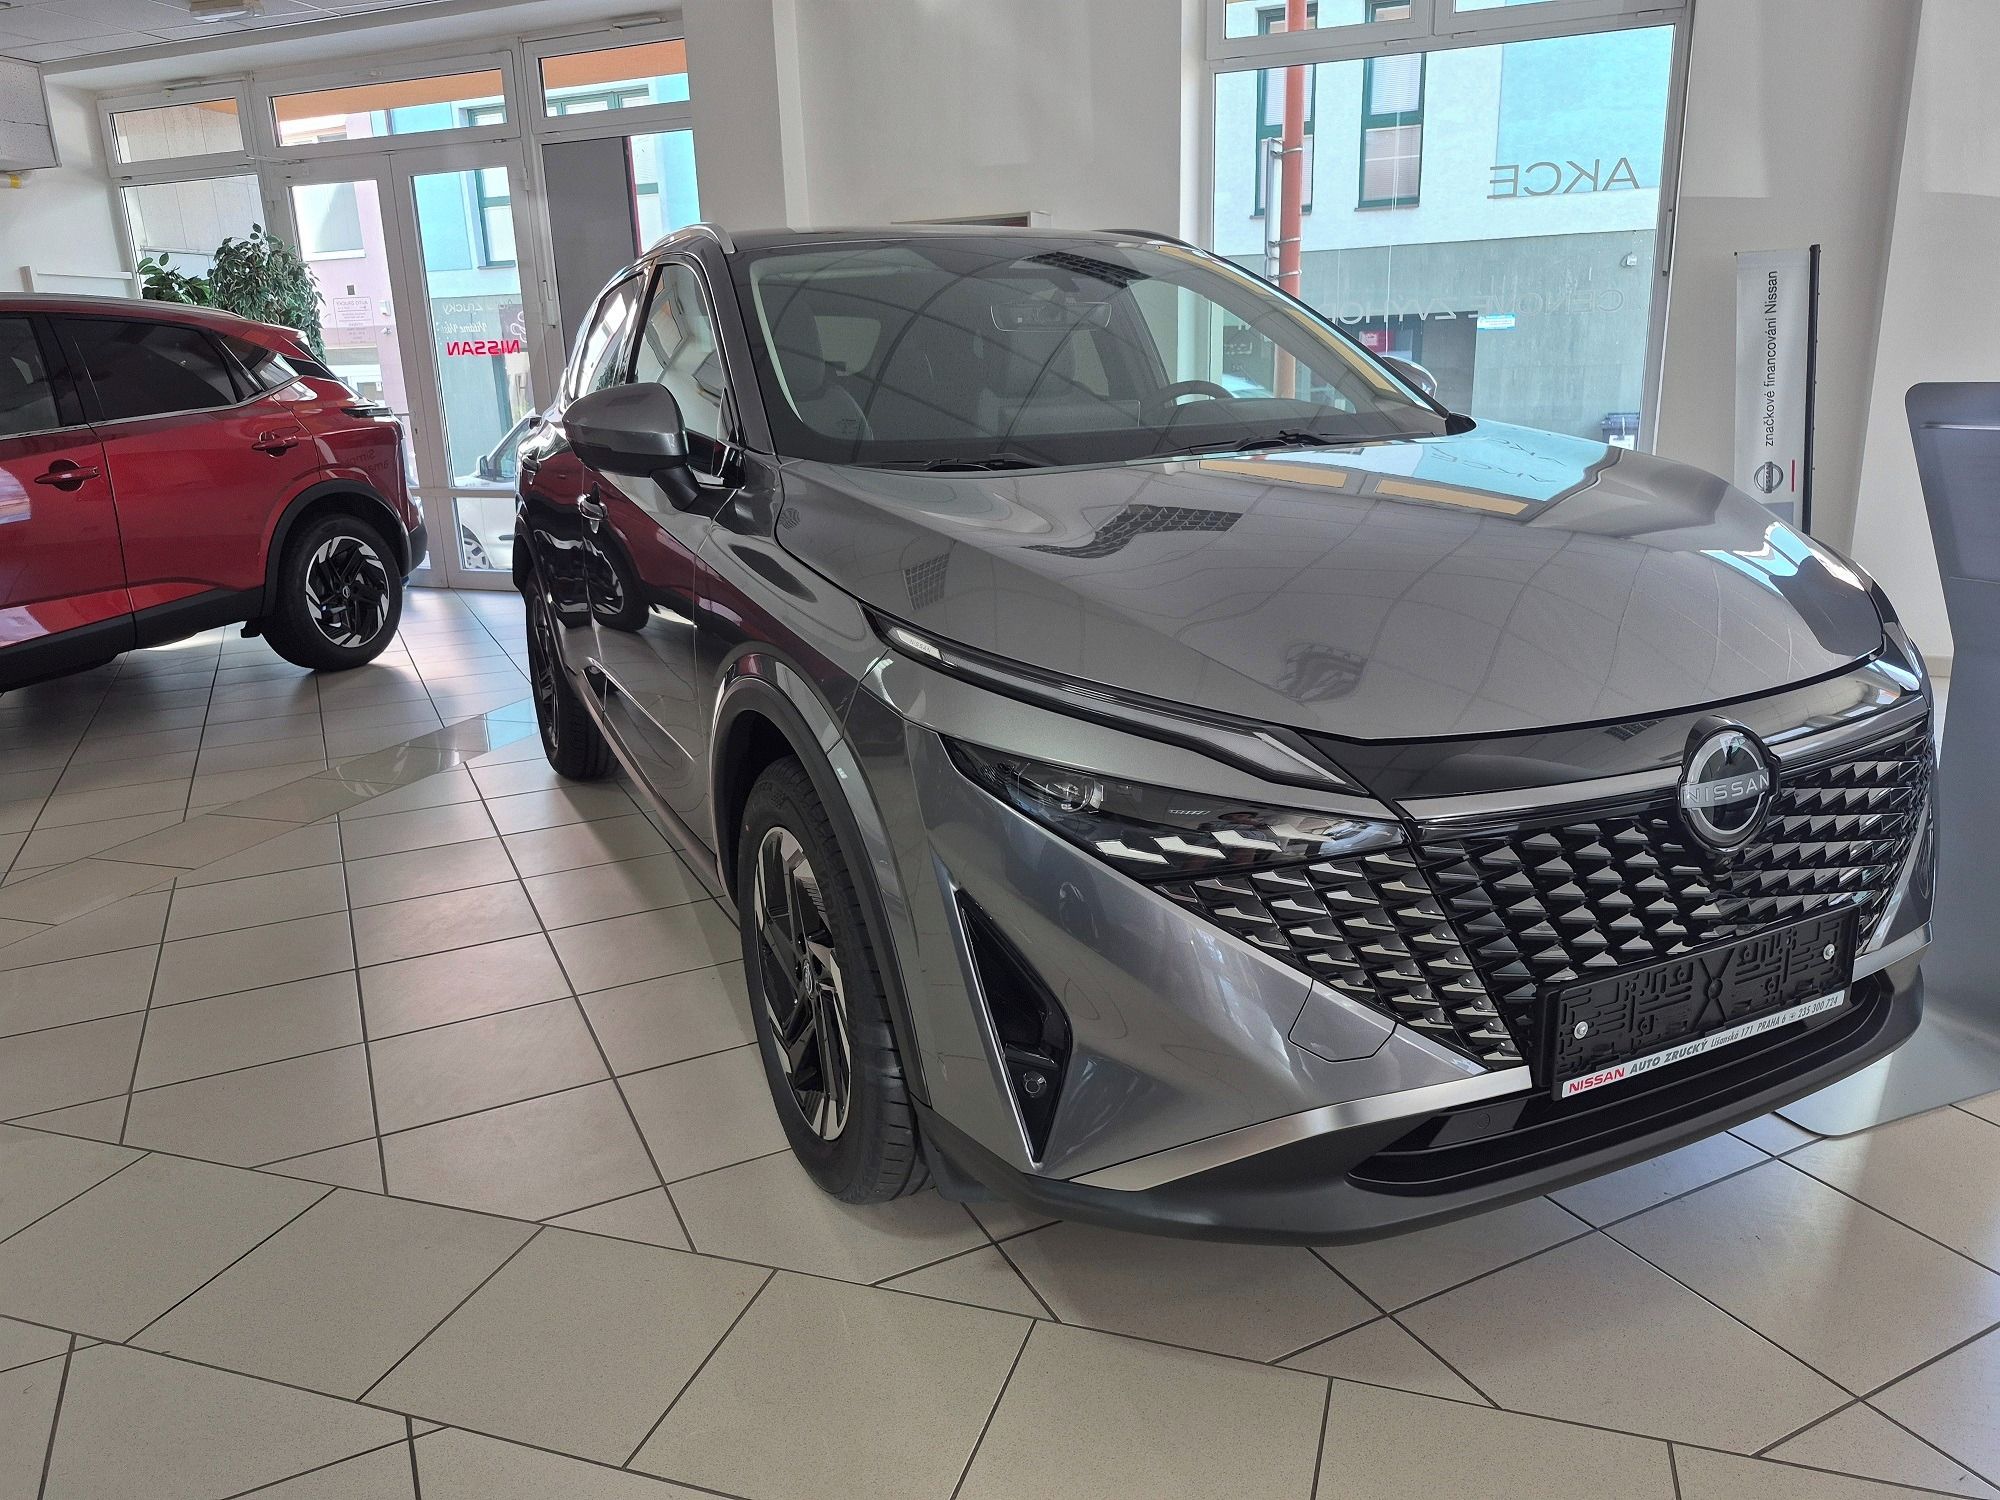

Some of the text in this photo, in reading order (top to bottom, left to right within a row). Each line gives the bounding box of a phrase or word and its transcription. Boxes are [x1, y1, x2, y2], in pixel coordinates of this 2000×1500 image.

[1763, 270, 1778, 447] značkové financování Nissan
[1682, 771, 1770, 806] NISSAN
[1569, 1067, 1625, 1093] NISSAN
[1629, 1056, 1660, 1075] AUTO
[1664, 1039, 1707, 1063] ZRUCKÝ
[1741, 1025, 1754, 1038] 171
[1756, 1016, 1780, 1032] PRAHA
[1781, 1014, 1786, 1024] 6
[1798, 1008, 1810, 1018] 235
[1811, 1002, 1825, 1014] 300
[1825, 996, 1838, 1008] 724
